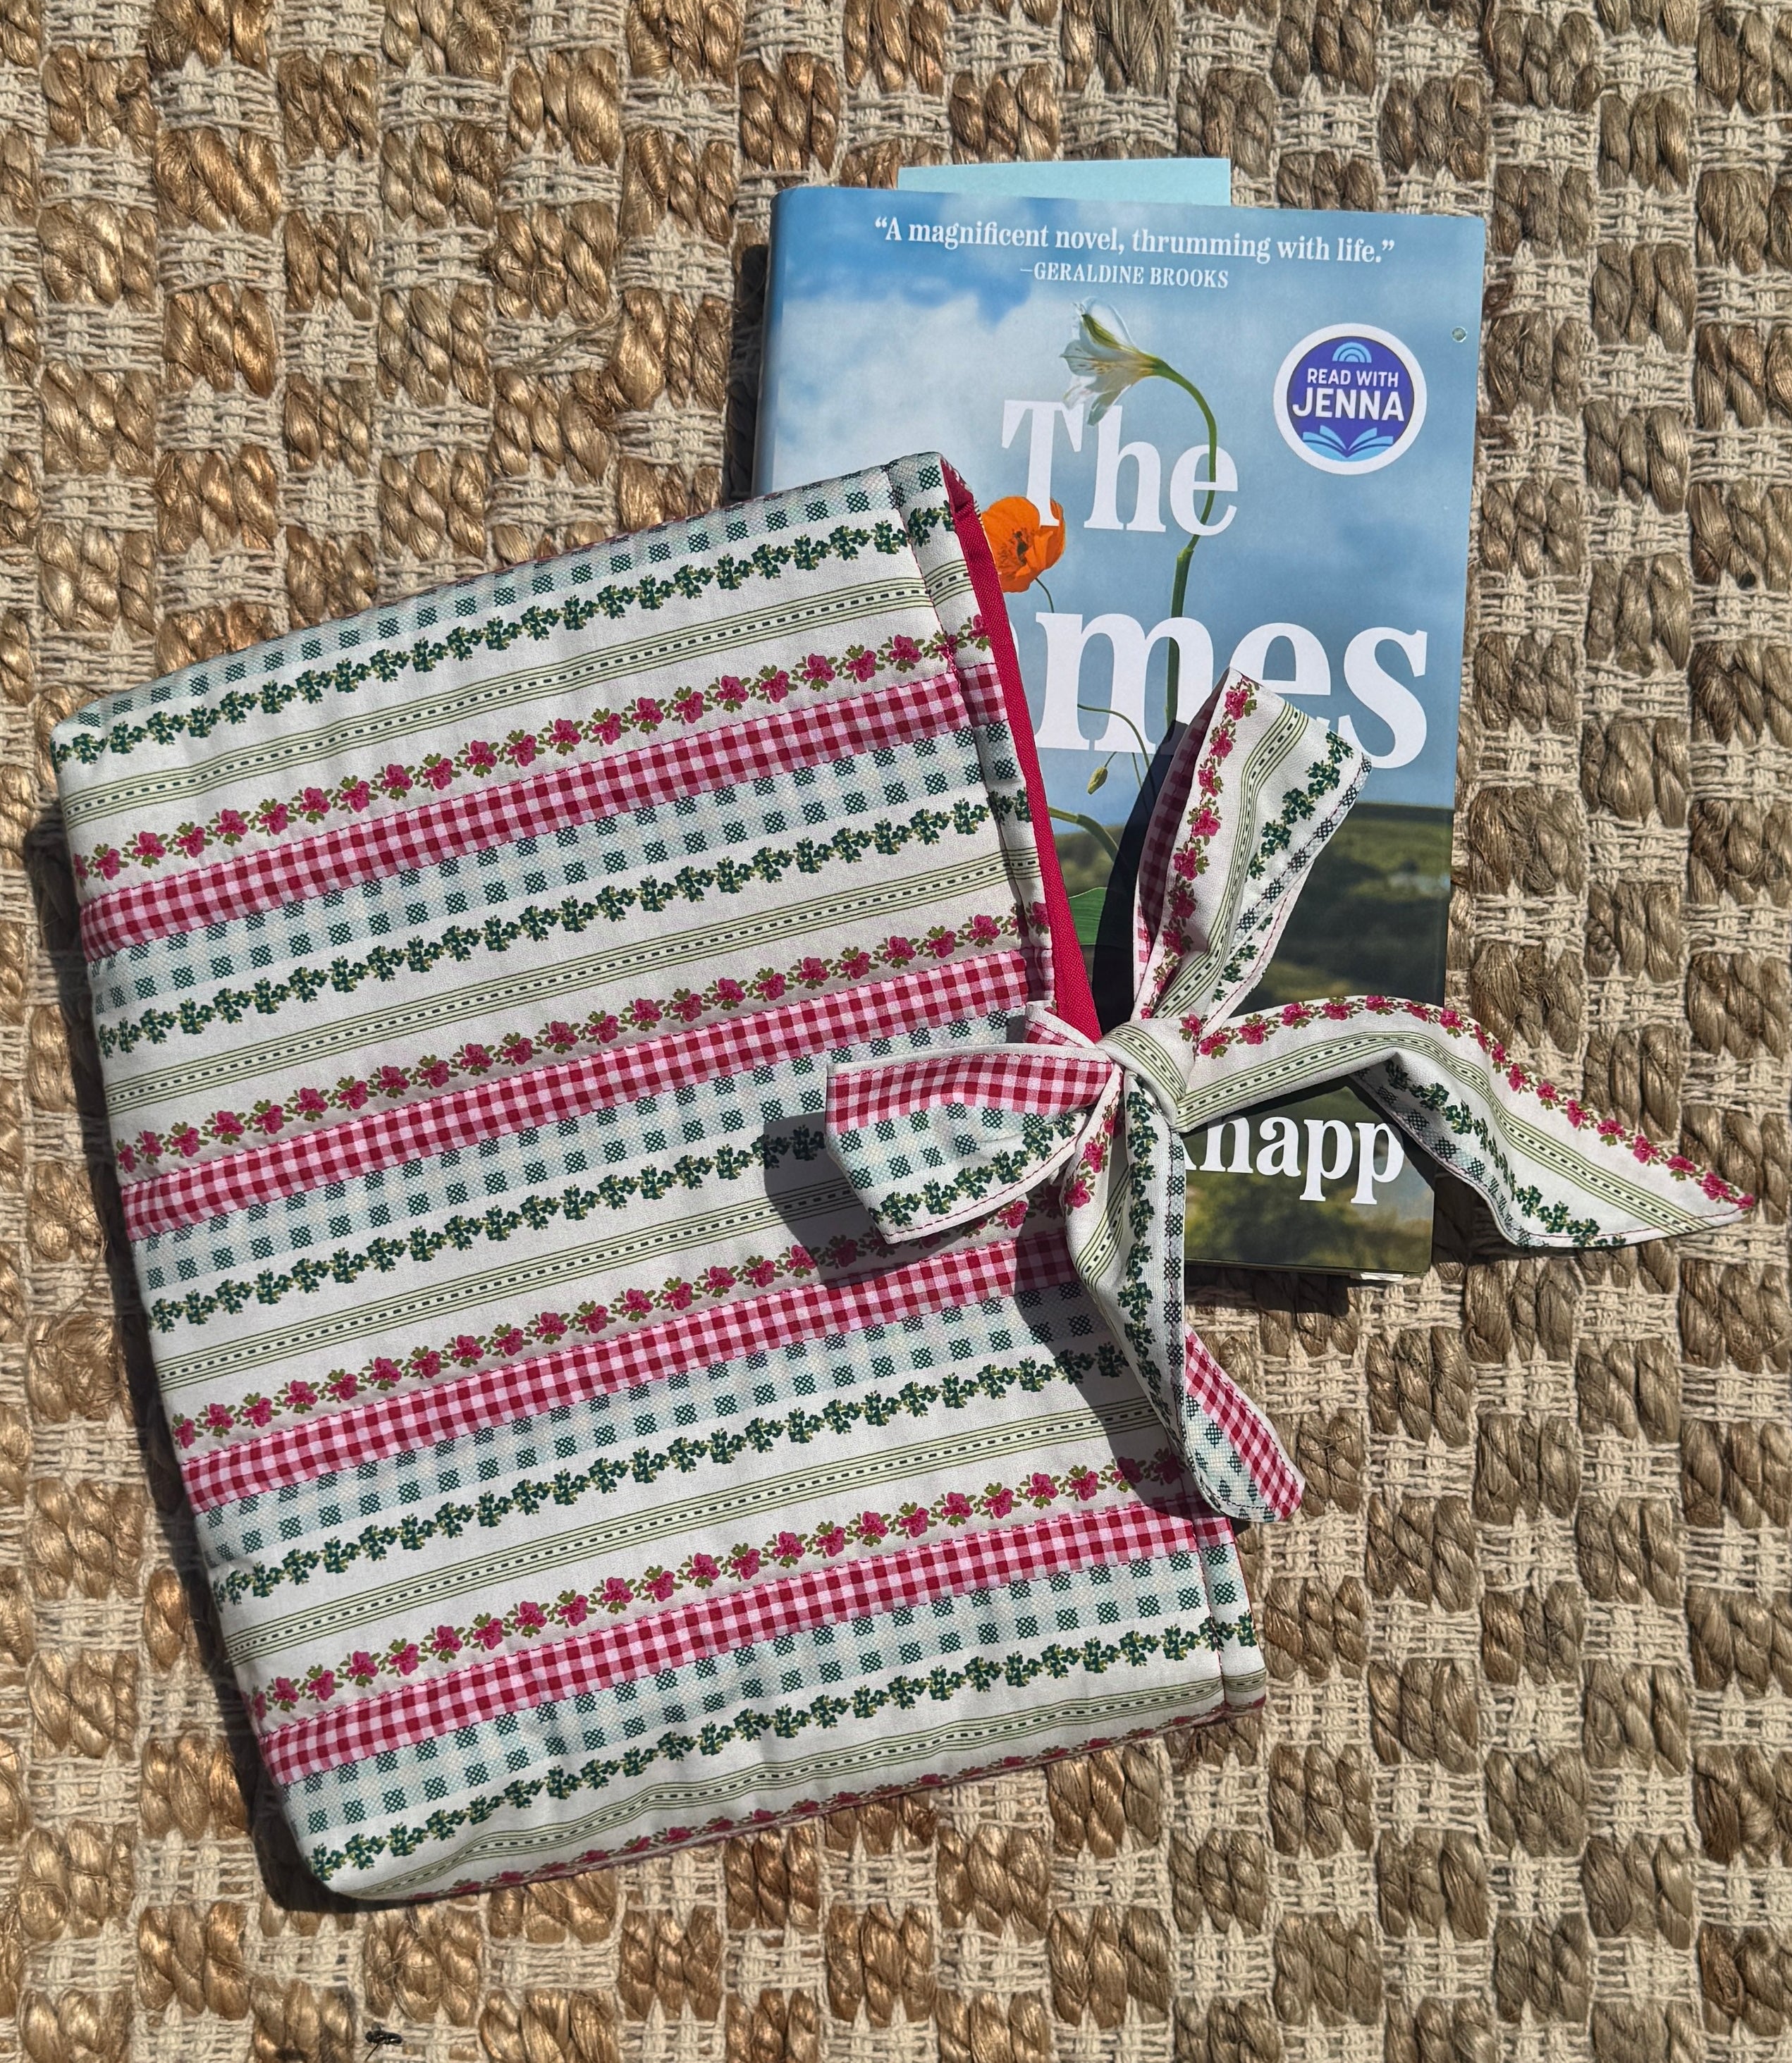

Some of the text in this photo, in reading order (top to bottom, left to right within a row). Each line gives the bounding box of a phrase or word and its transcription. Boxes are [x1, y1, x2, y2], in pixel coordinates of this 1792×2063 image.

[874, 216, 1396, 264] “A magnificent novel, thrumming with life.”
[1149, 266, 1229, 289] BROOKS
[1307, 367, 1399, 388] READ WITH
[1291, 386, 1405, 422] JENNA
[1000, 399, 1239, 536] The
[1010, 611, 1429, 770] mes
[1184, 1115, 1405, 1205] napp
